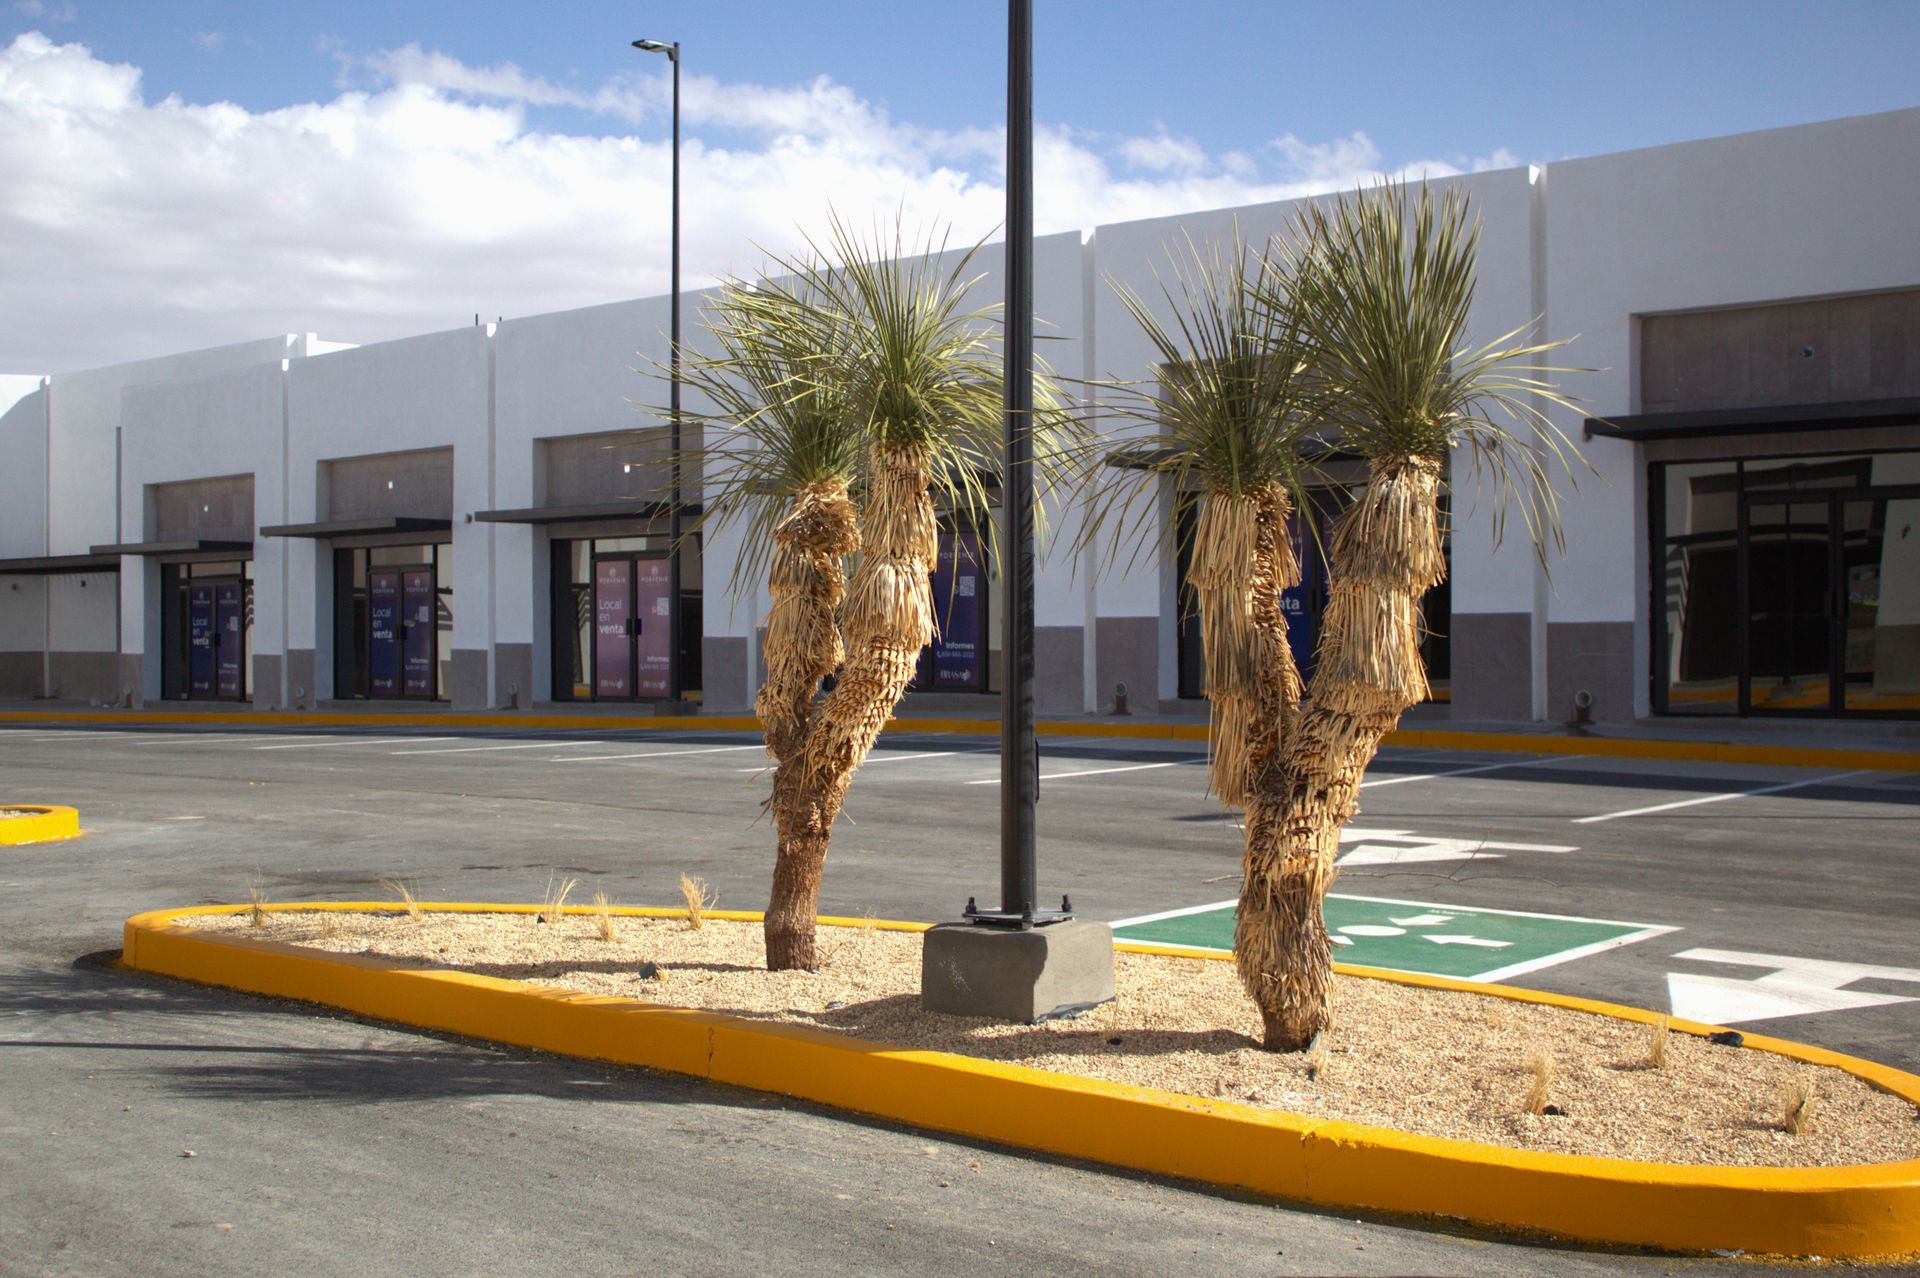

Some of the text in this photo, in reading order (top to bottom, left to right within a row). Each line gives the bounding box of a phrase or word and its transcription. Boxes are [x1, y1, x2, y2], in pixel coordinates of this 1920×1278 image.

[599, 600, 621, 609] Local
[1280, 597, 1300, 609] nta
[373, 608, 391, 617] Local
[193, 616, 208, 626] Local
[599, 613, 610, 622] en
[373, 620, 382, 628] en
[599, 624, 624, 634] venta
[372, 629, 392, 639] venta
[193, 637, 209, 645] venta
[945, 641, 974, 649] Informes
